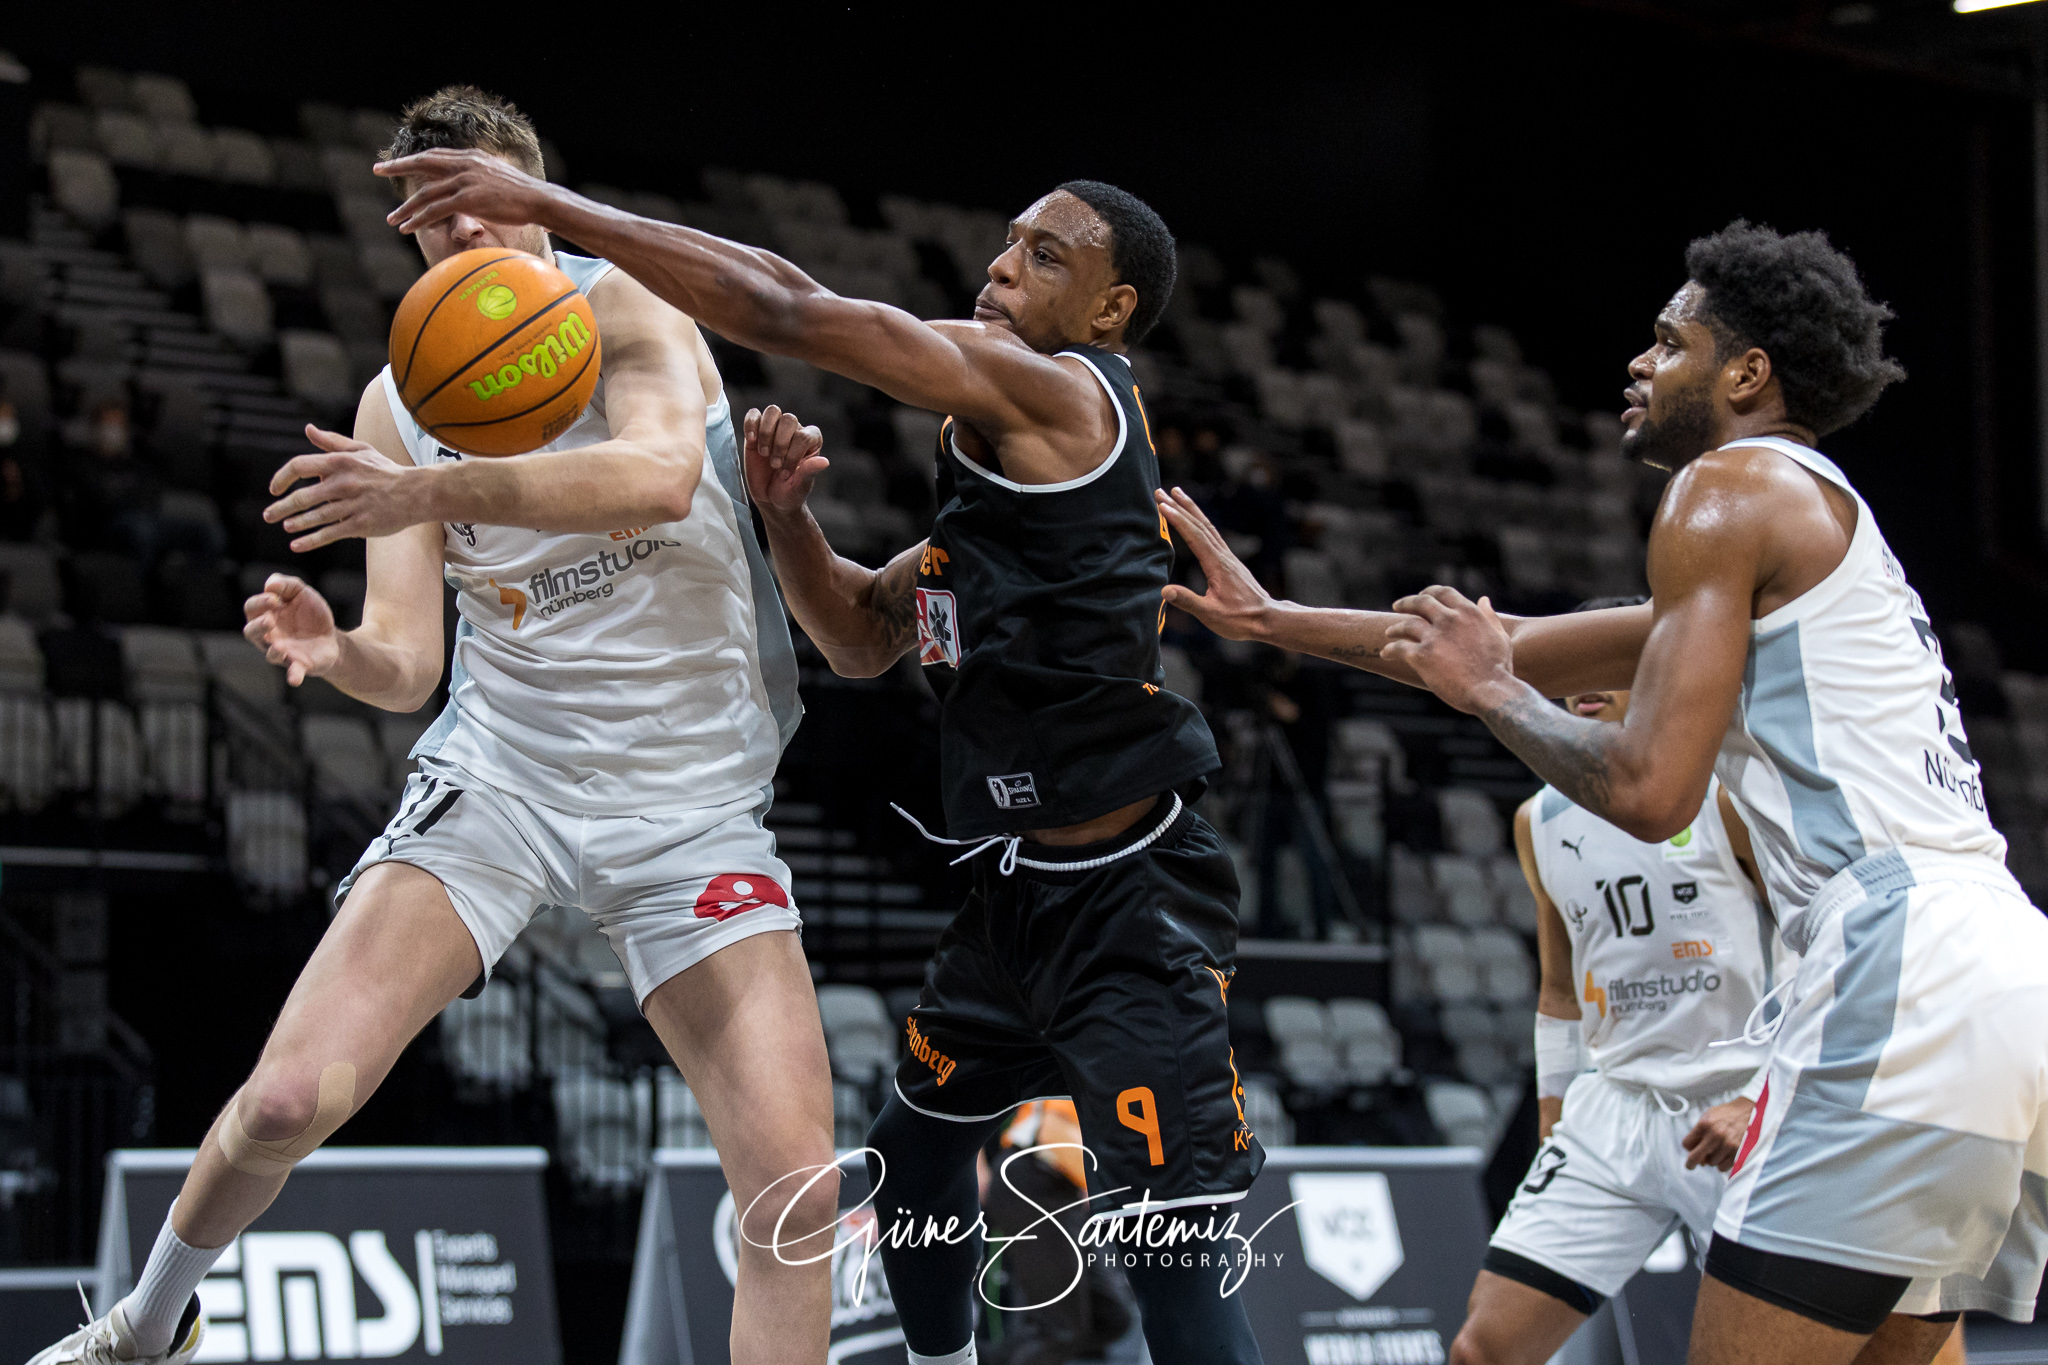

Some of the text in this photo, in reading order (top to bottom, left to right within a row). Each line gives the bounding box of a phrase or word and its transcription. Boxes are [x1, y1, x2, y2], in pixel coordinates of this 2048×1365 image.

[459, 271, 499, 300] BARMER
[468, 312, 591, 401] Wilson
[540, 583, 614, 617] nürnberg
[1008, 784, 1033, 795] SPALDING
[1595, 874, 1655, 938] 10
[1671, 939, 1713, 960] EMS
[1608, 968, 1721, 1001] filmstudio
[1116, 1086, 1165, 1167] 9
